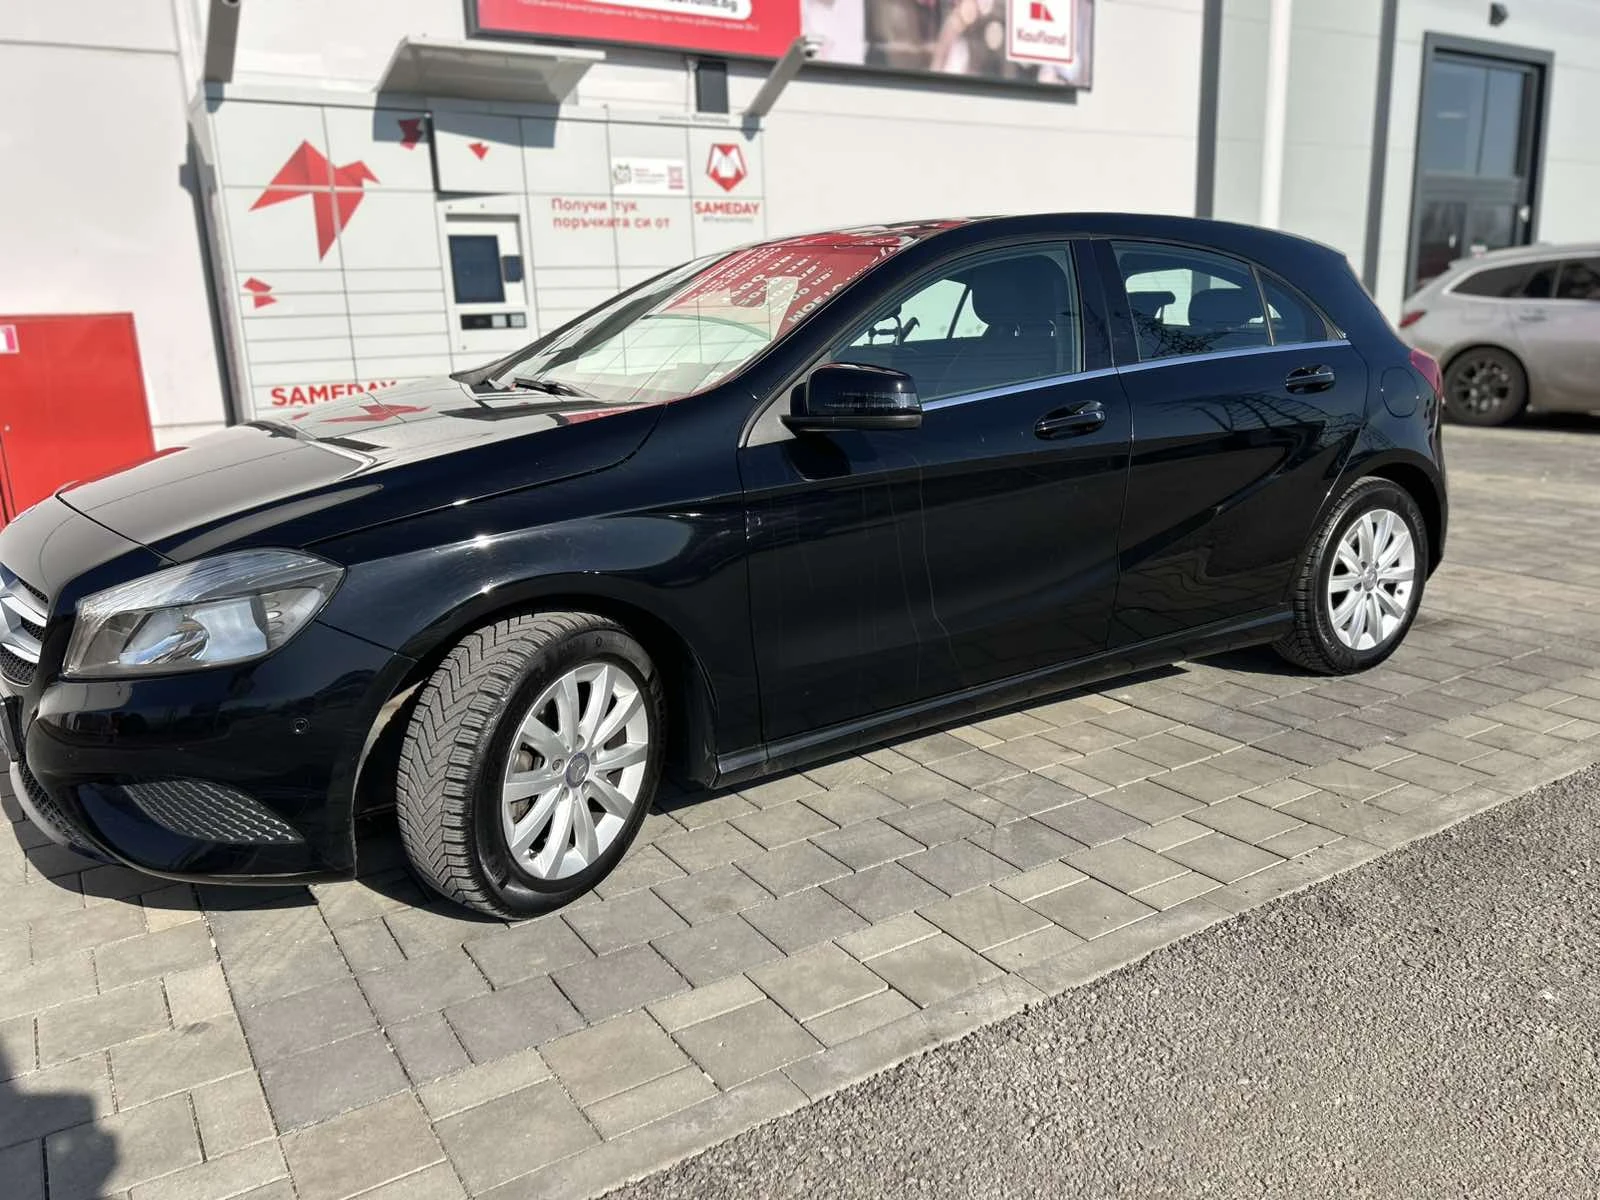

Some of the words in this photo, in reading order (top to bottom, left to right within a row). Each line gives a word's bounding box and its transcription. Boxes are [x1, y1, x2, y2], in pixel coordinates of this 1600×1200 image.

[552, 198, 607, 213] Получи
[613, 201, 637, 213] тук
[694, 201, 760, 215] SAMEDAY
[553, 217, 630, 229] поръчката
[635, 218, 651, 228] си
[656, 217, 670, 228] от
